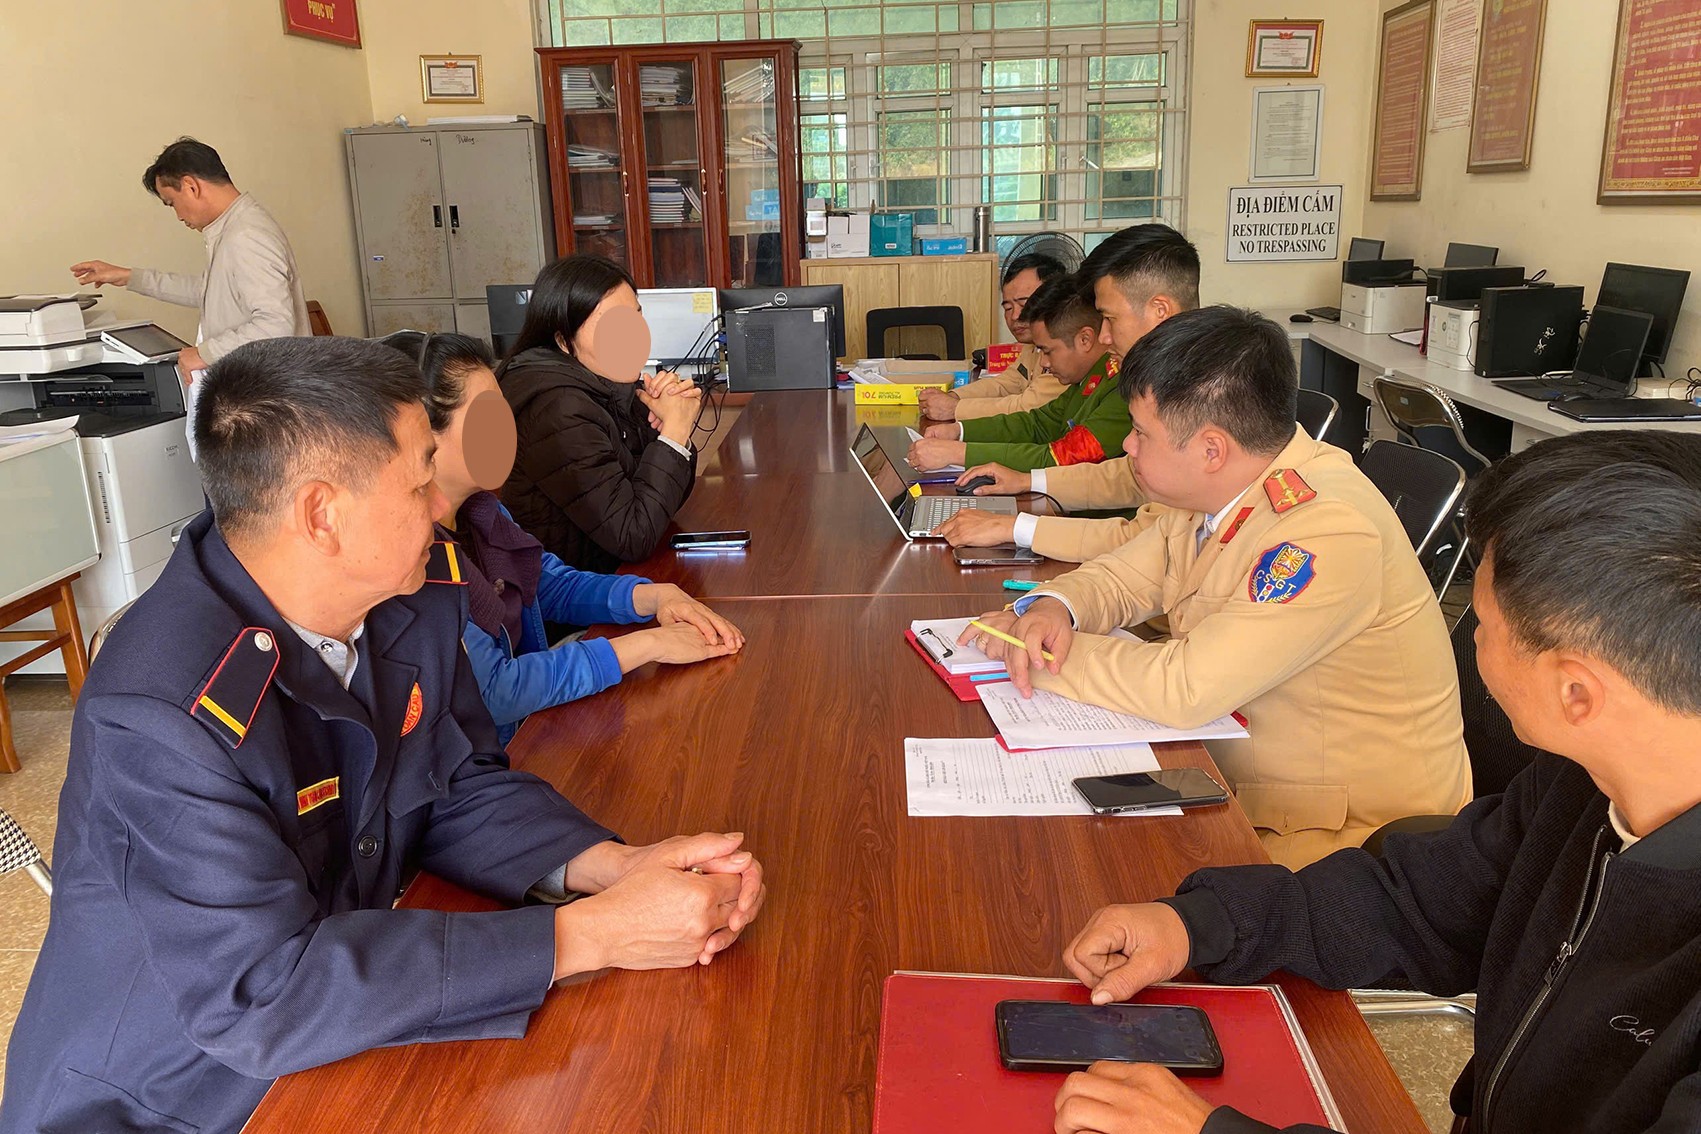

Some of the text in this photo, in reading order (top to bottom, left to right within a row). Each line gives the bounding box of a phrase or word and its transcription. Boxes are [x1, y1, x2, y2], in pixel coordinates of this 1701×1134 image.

[1236, 190, 1334, 218] ĐỊA ĐIỂM CẤM
[1232, 222, 1335, 237] RESTRICTED PLACE
[1239, 239, 1327, 253] NO TRESPASSING
[1256, 569, 1297, 593] CSGT
